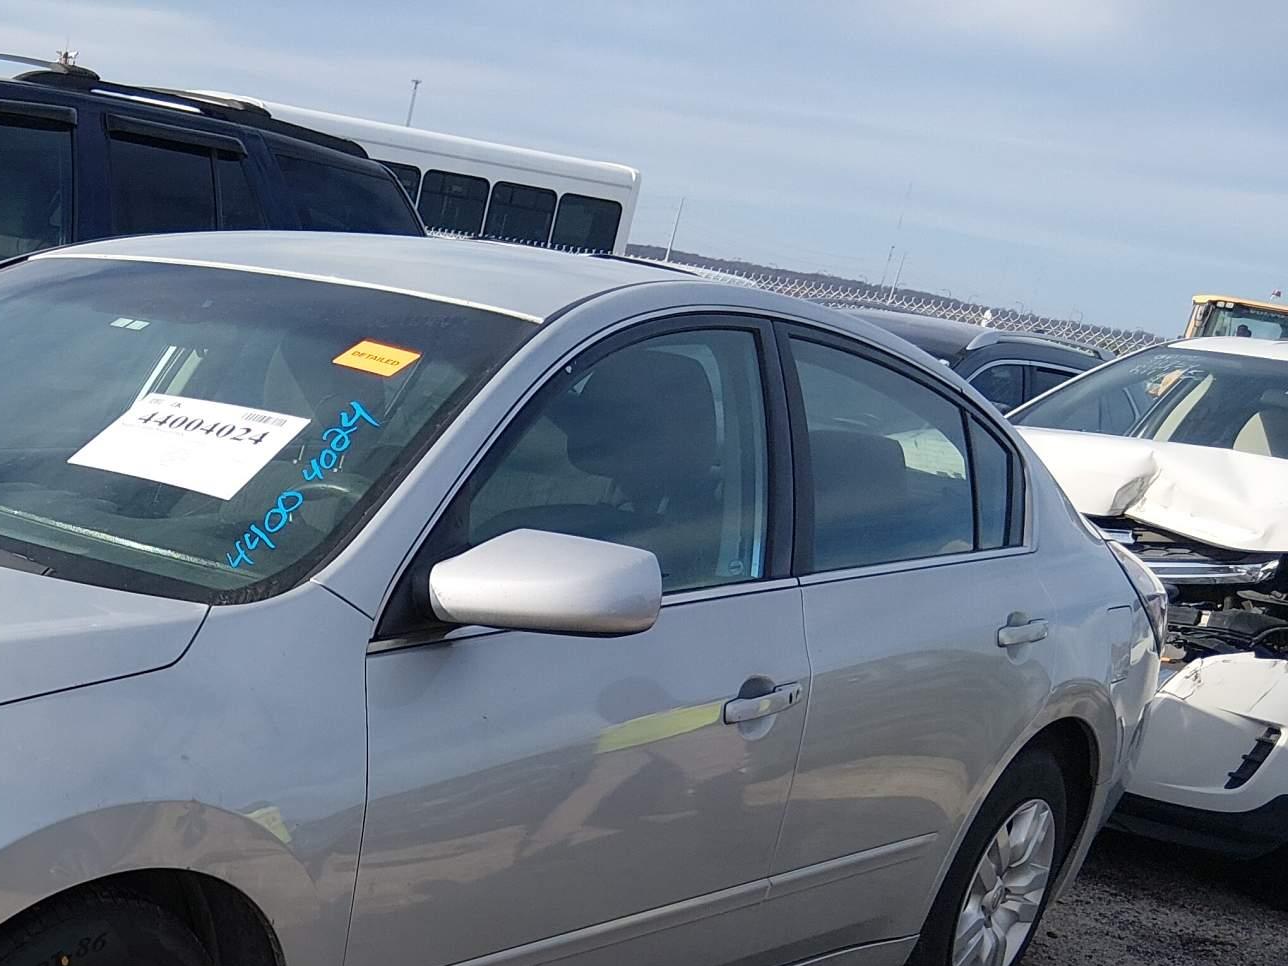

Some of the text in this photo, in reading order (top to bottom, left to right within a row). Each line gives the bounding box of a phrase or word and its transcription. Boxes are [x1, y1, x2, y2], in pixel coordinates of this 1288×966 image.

[351, 350, 400, 366] DETAILED
[138, 411, 271, 445] 44004024
[226, 400, 381, 569] 4400 4024
